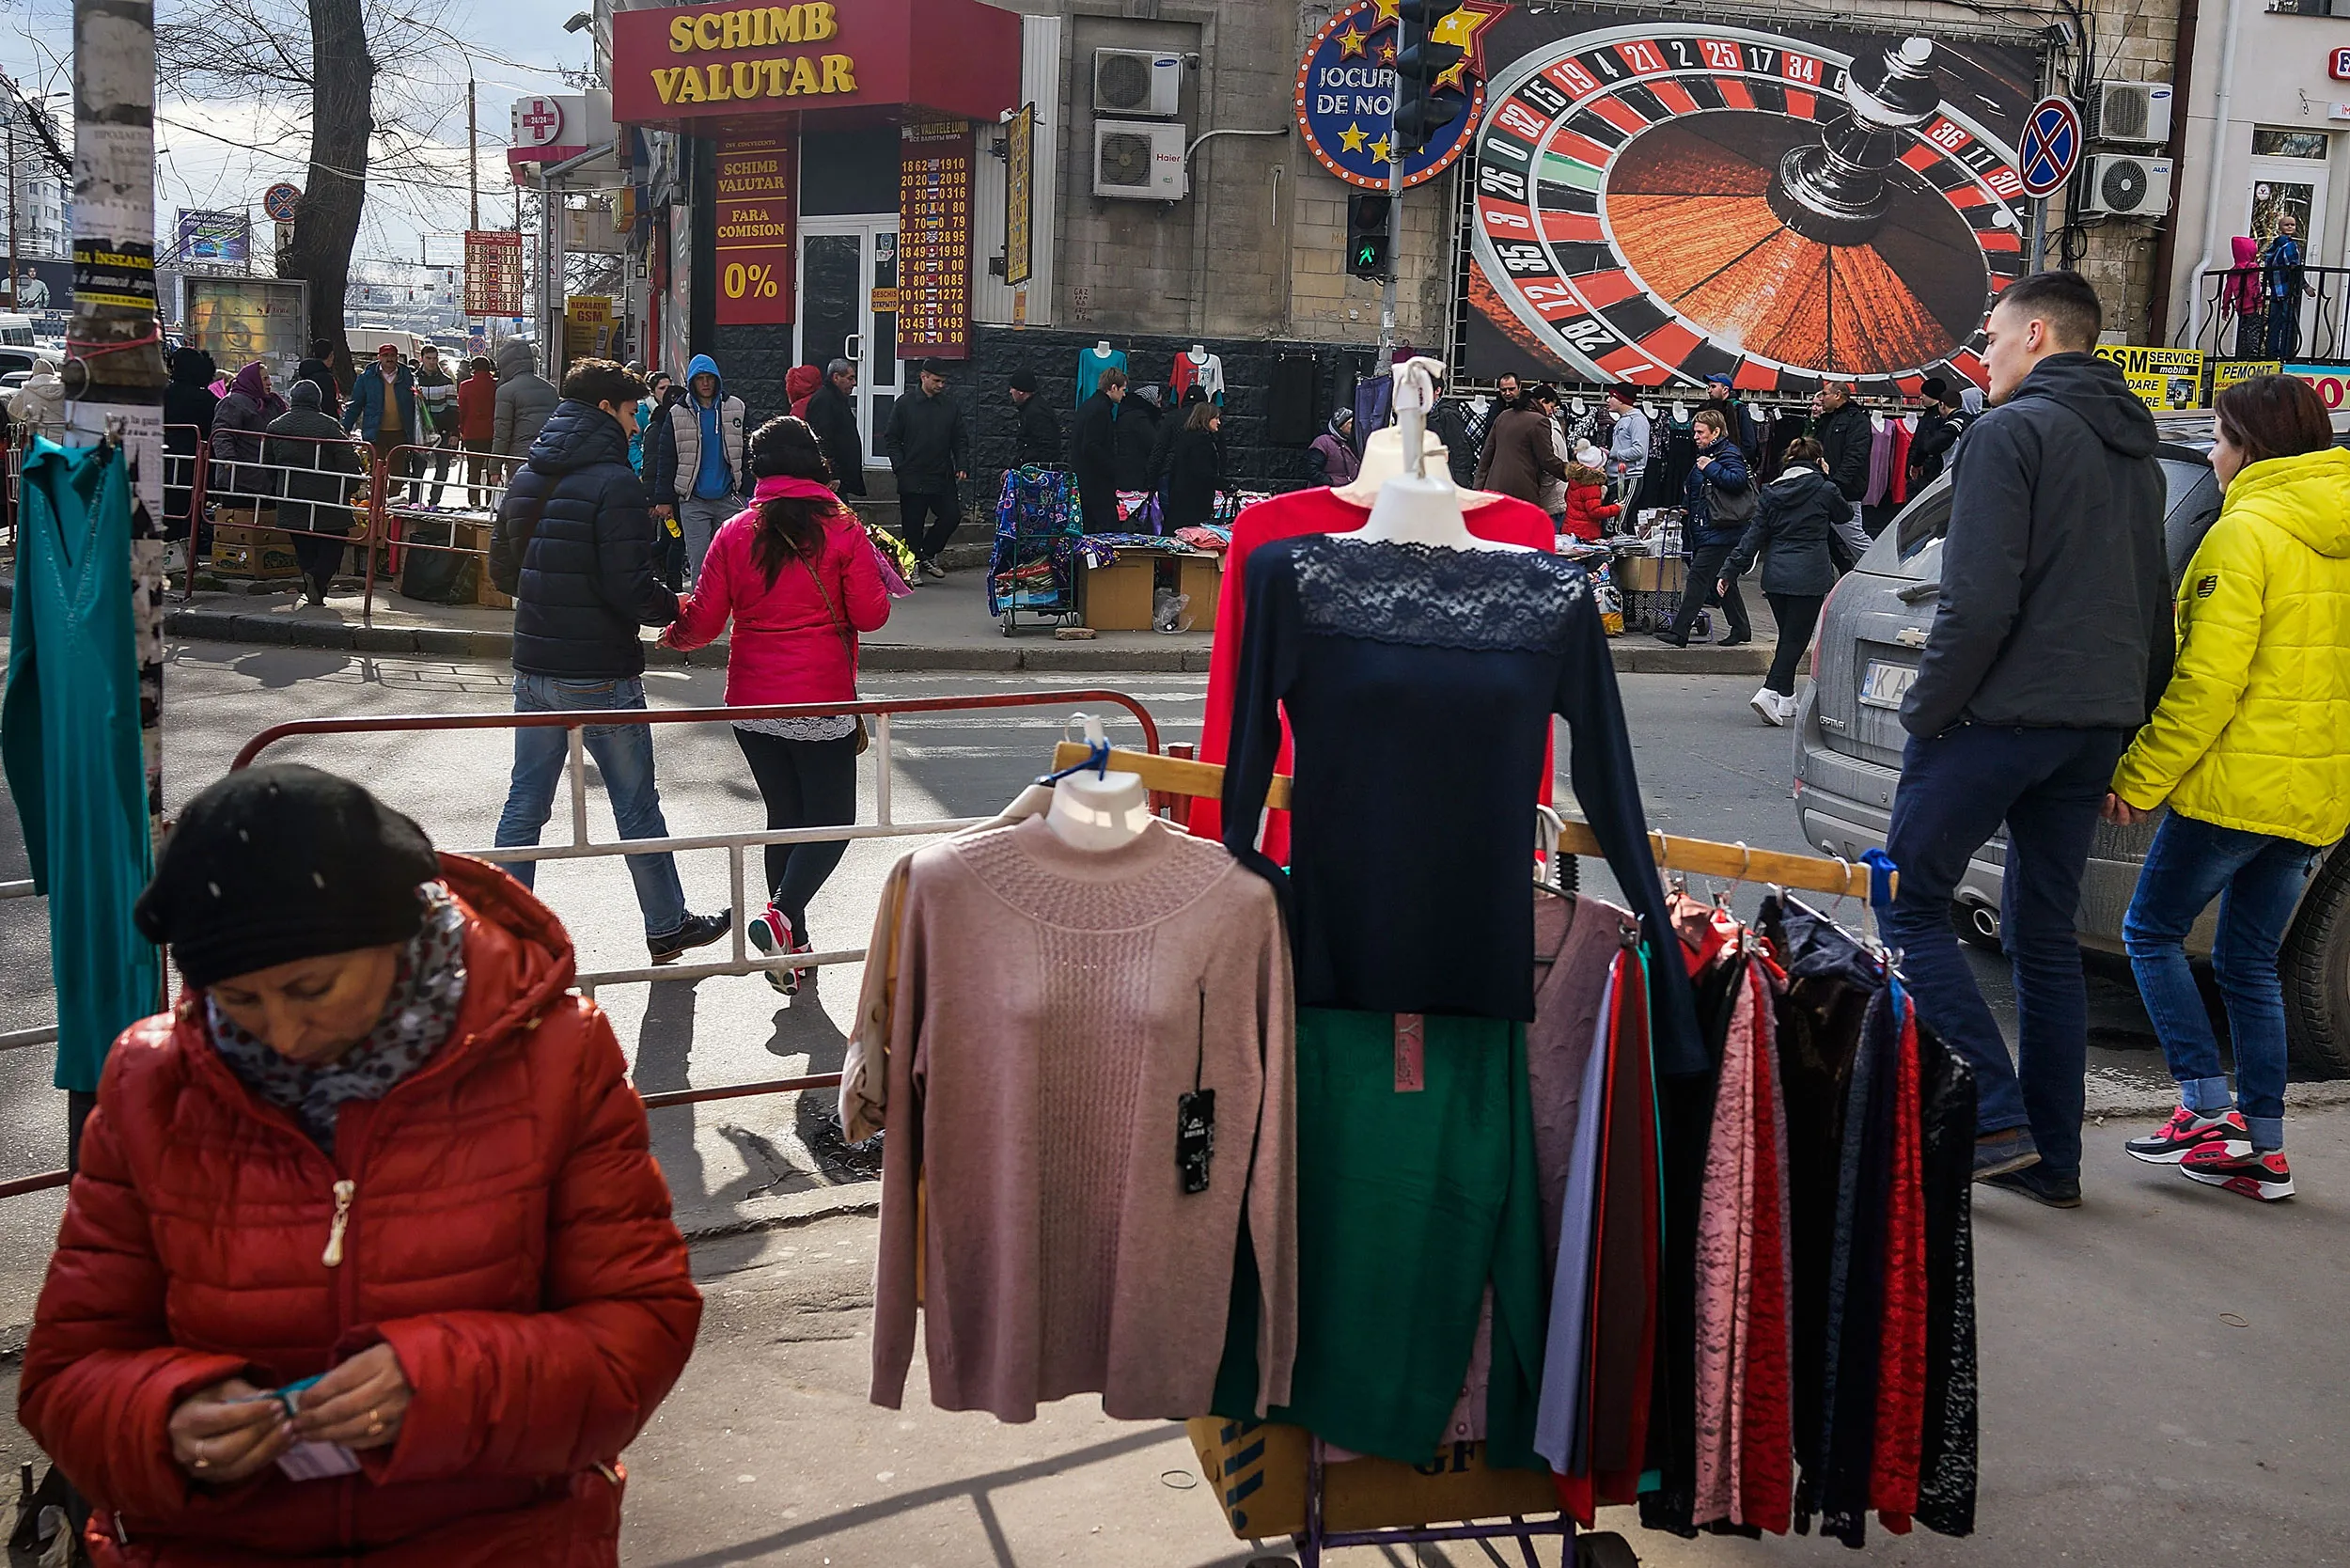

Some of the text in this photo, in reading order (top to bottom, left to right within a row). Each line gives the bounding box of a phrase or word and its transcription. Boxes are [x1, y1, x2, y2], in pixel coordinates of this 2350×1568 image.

[668, 2, 838, 53] SCHIMB
[1594, 52, 1619, 78] 4
[1623, 43, 1662, 71] 21
[1671, 41, 1693, 67] 2
[1706, 41, 1737, 68] 25
[1749, 47, 1774, 72] 17
[650, 55, 857, 104] VALUTAR
[1318, 68, 1396, 88] JOCUR
[1552, 63, 1594, 95] 19
[1789, 55, 1813, 81] 34
[1317, 94, 1349, 114] DE
[1524, 79, 1567, 115] 15
[530, 116, 548, 124] 24/24
[921, 121, 951, 135] VALUTELE
[1499, 104, 1545, 137] 32
[1932, 122, 1966, 149] 36
[1156, 153, 1181, 163] Haier
[1487, 138, 1528, 162] 0
[1961, 146, 1995, 171] 11
[724, 160, 778, 176] SCHIMB
[718, 176, 785, 193] VALUTAR
[1481, 166, 1524, 200] 26
[1988, 171, 2021, 194] 30
[717, 223, 785, 238] COMISION
[1486, 211, 1529, 228] 3
[1496, 244, 1549, 272] 35
[724, 262, 777, 299] 0%
[872, 300, 897, 308] ОТКРЫТО
[1524, 283, 1579, 311] 12
[577, 310, 603, 322] GSM
[1560, 319, 1616, 353] 28
[2149, 352, 2201, 364] SERVICE
[2159, 366, 2189, 375] mobile
[1615, 363, 1653, 383] 7
[1820, 715, 1845, 730] CAPTIVA
